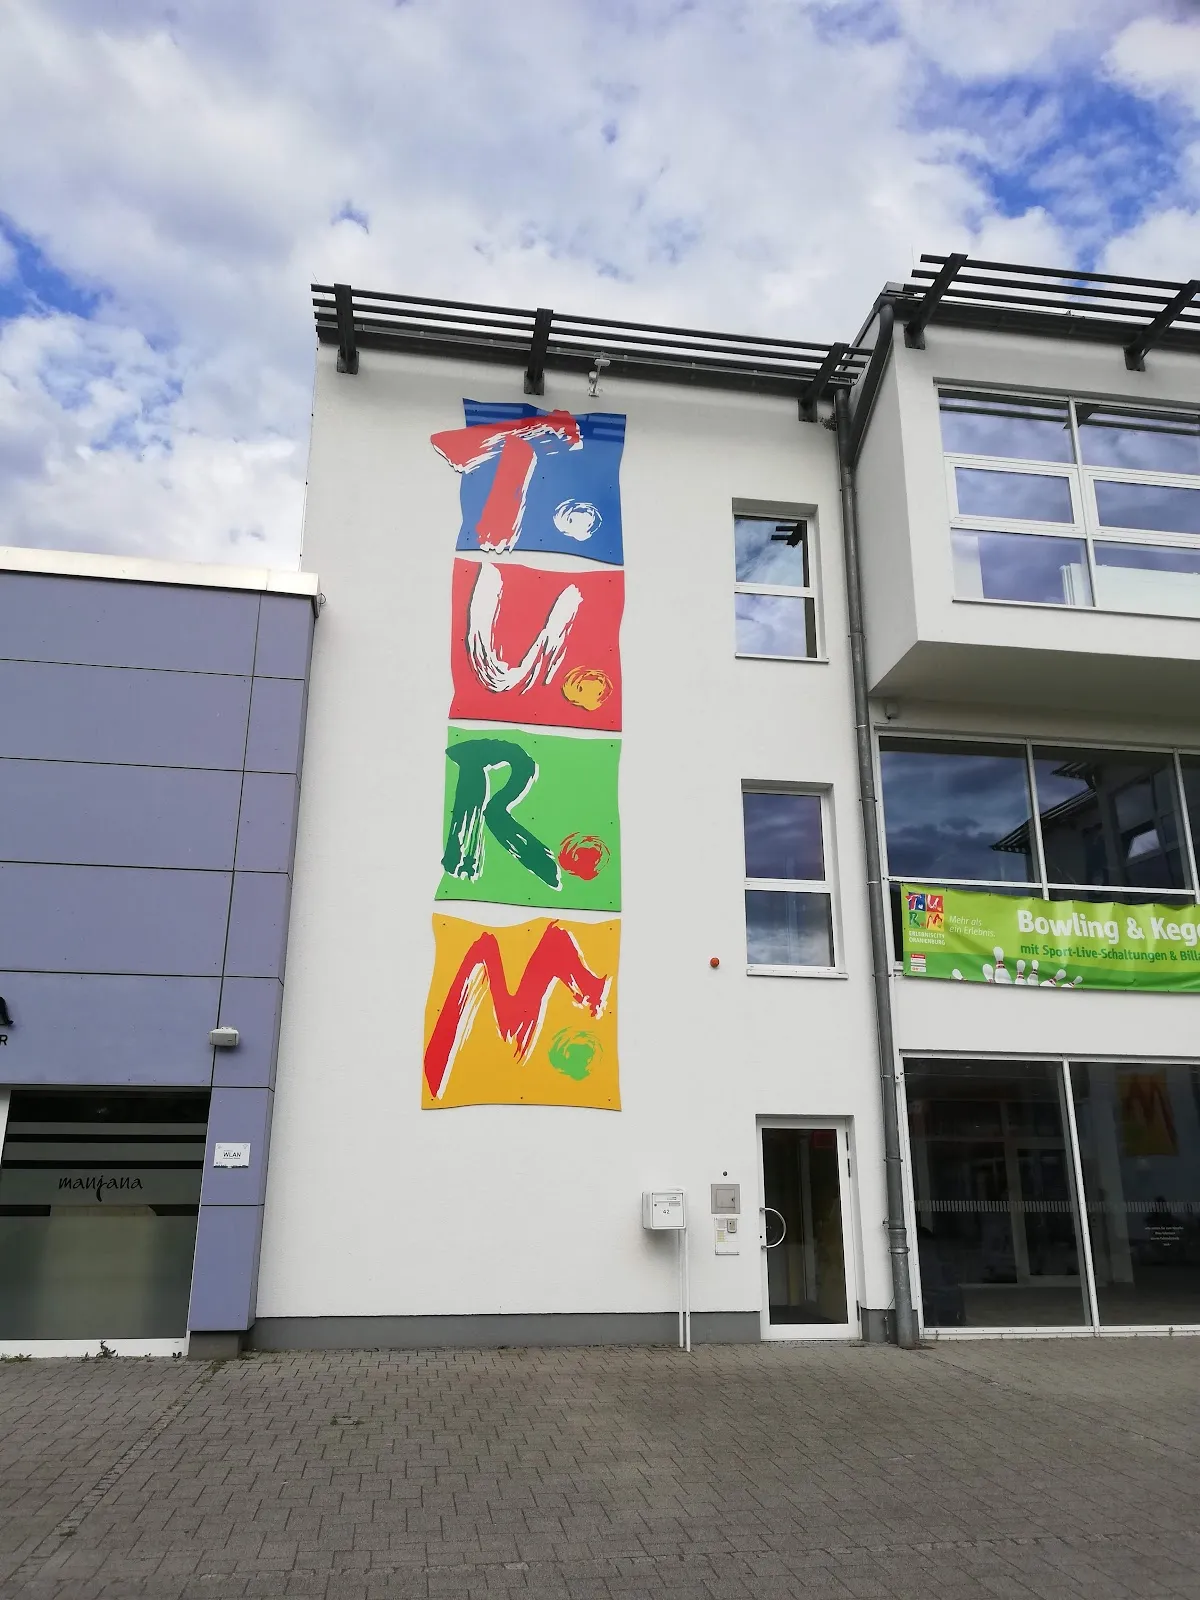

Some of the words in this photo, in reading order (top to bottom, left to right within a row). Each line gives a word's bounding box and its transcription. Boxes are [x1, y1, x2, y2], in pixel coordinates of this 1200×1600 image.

[949, 915, 969, 925] Mehr
[970, 918, 982, 926] als
[1017, 909, 1119, 945] Bowling
[1126, 916, 1146, 940] &
[1150, 917, 1200, 947] Keg
[949, 925, 962, 933] ein
[963, 927, 996, 937] Erlebnis.
[1020, 944, 1040, 955] mit
[1042, 944, 1168, 963] Sport-Live-Schaltungen
[1169, 950, 1178, 961] &
[58, 1175, 144, 1202] manjana
